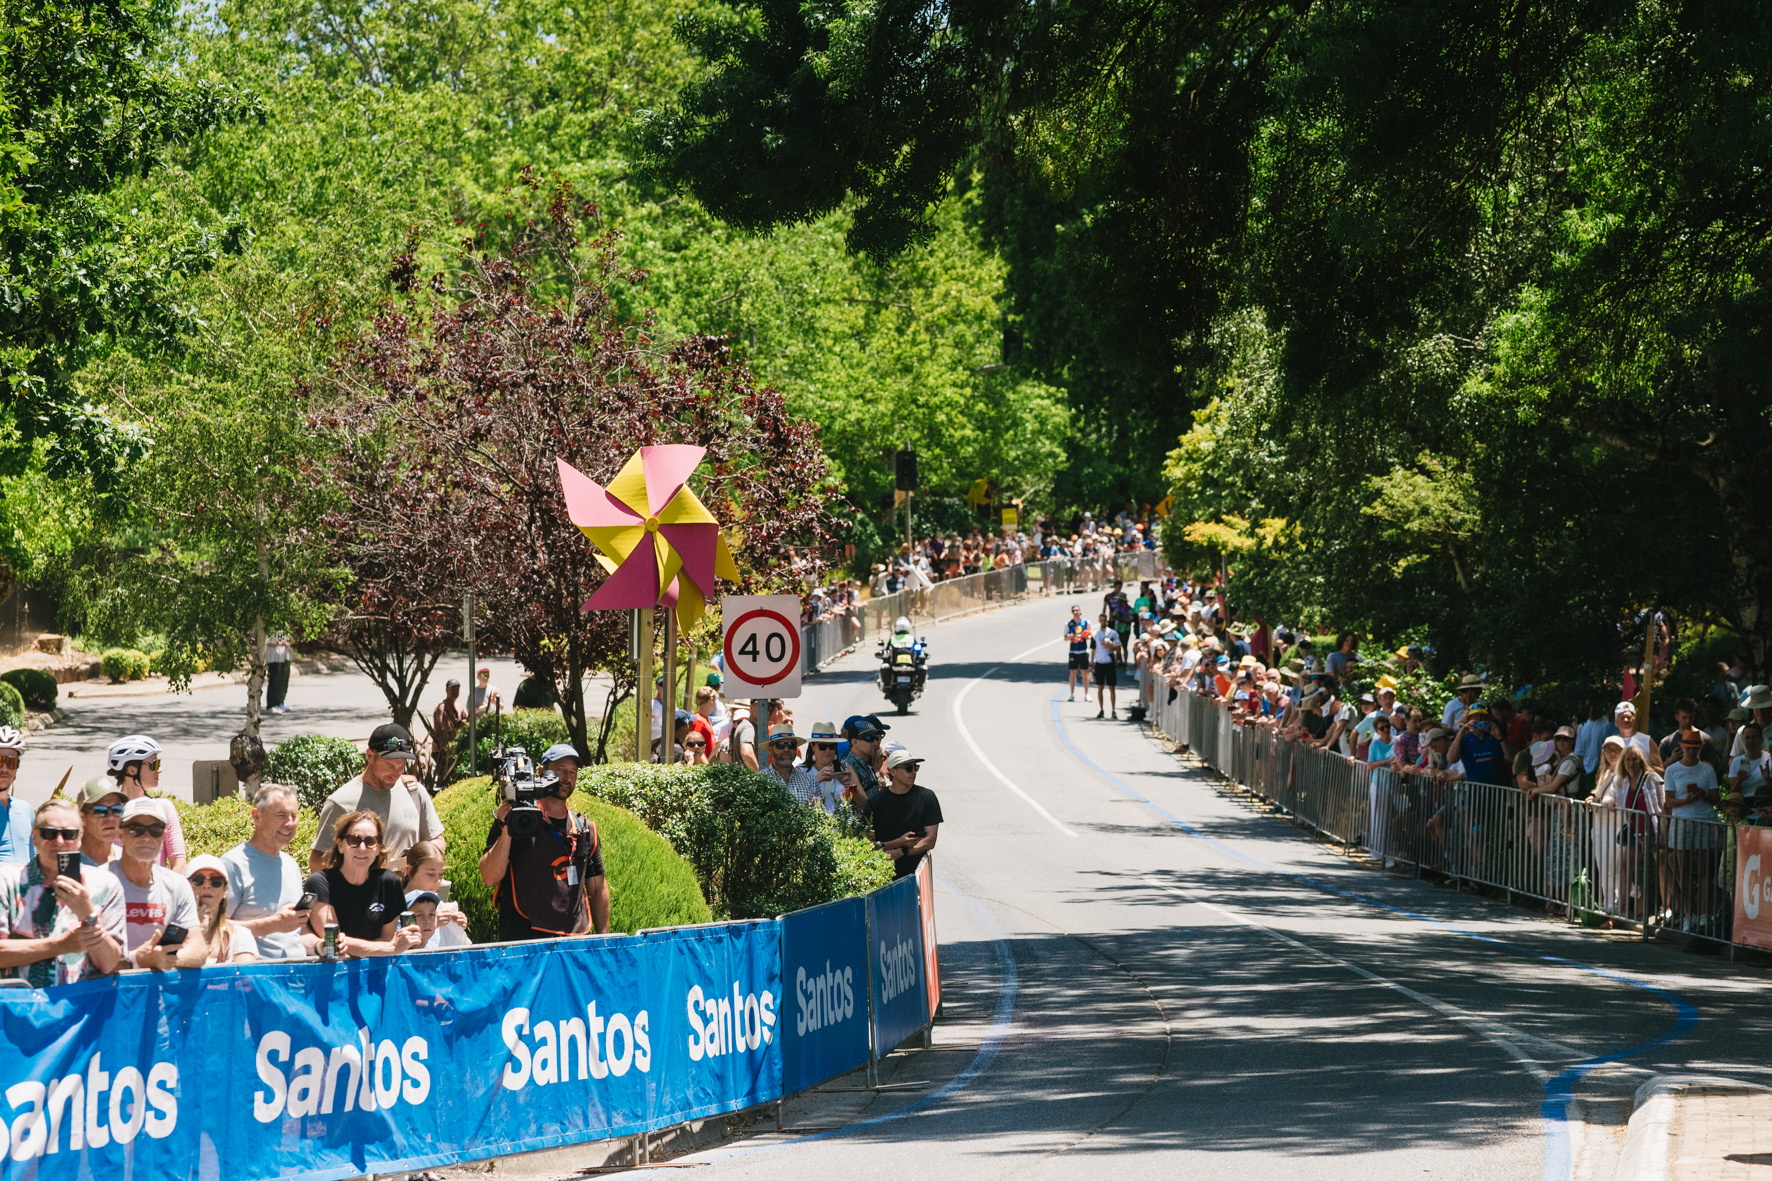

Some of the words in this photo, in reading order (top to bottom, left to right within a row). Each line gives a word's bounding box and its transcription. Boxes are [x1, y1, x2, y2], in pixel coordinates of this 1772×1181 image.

[738, 632, 786, 663] 40
[796, 959, 854, 1037] Santos
[880, 933, 916, 1004] Santos
[502, 999, 651, 1090] Santos
[688, 980, 777, 1061] Santos
[254, 1026, 431, 1123] Santos
